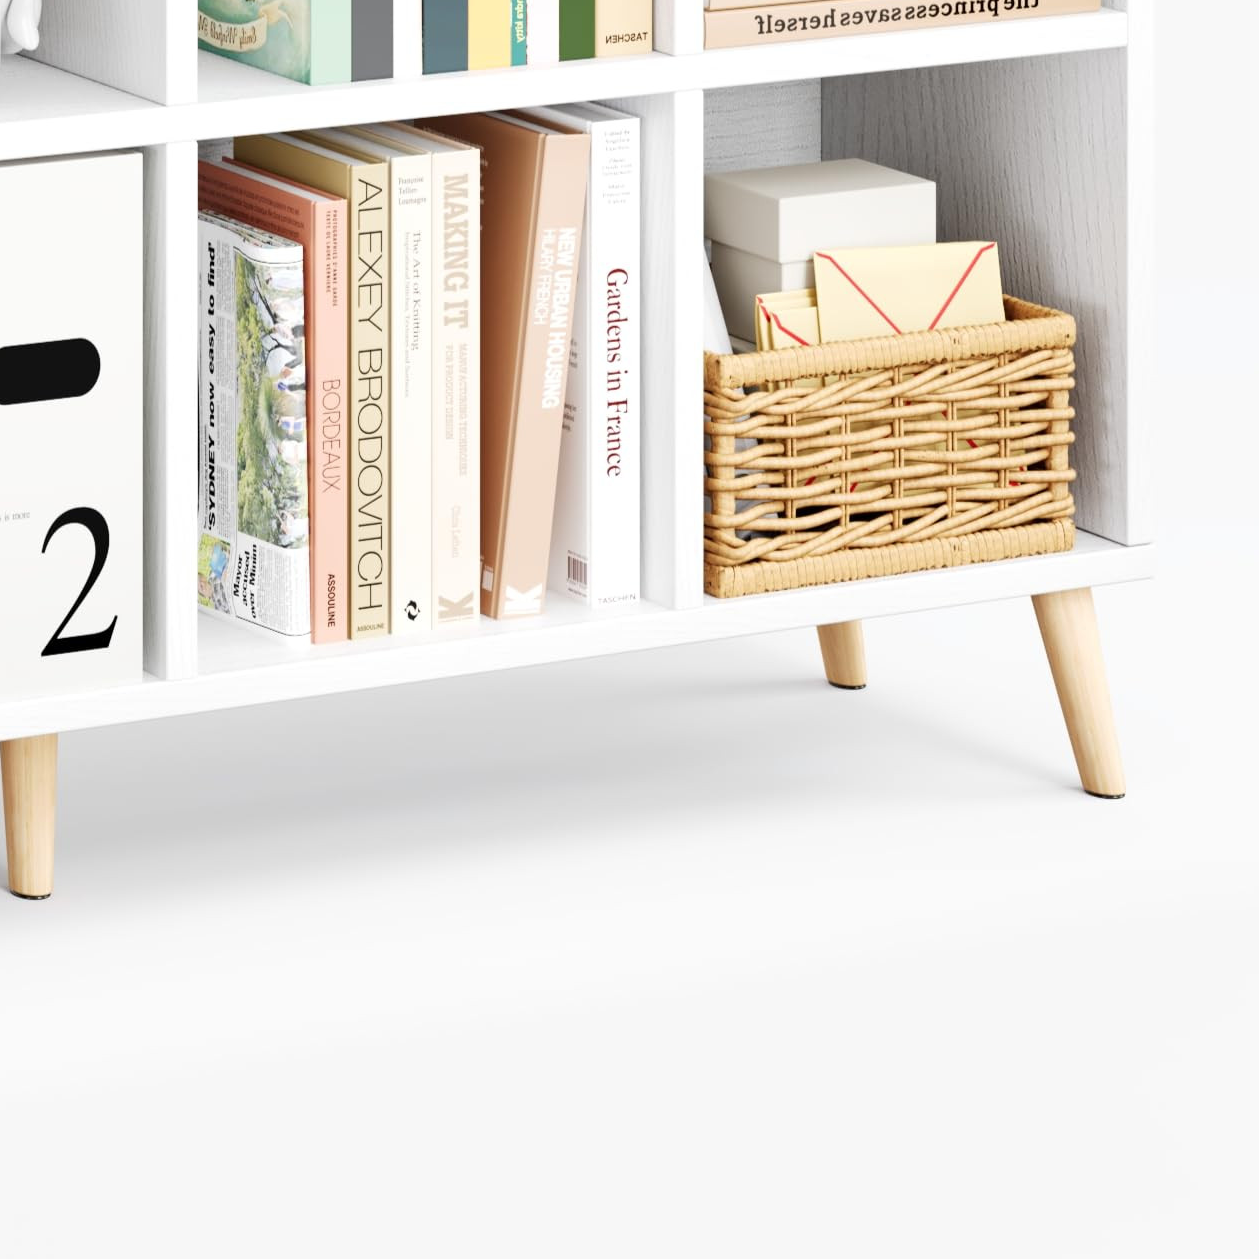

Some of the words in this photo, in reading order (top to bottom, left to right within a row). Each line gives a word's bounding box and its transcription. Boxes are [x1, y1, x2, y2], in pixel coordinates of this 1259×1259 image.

[357, 178, 383, 332] ALEXEY
[413, 230, 422, 255] The
[443, 173, 469, 292] MAKING
[556, 227, 577, 267] NEW
[413, 258, 421, 278] Art
[413, 283, 421, 294] of
[208, 294, 215, 316] to
[443, 299, 469, 329] IT
[533, 274, 552, 325] FRENCH
[549, 269, 573, 328] URBAN
[606, 268, 629, 363] Gardens
[208, 323, 216, 375] easy
[411, 299, 422, 351] Knitting
[541, 331, 567, 409] HOUSING
[607, 370, 628, 392] in
[322, 379, 341, 493] BORDEAUX
[607, 398, 628, 477] France
[357, 348, 383, 611] BRODOVITCH
[41, 506, 118, 657] 2
[233, 554, 243, 597] Mayor
[327, 573, 336, 628] ASSOULINE
